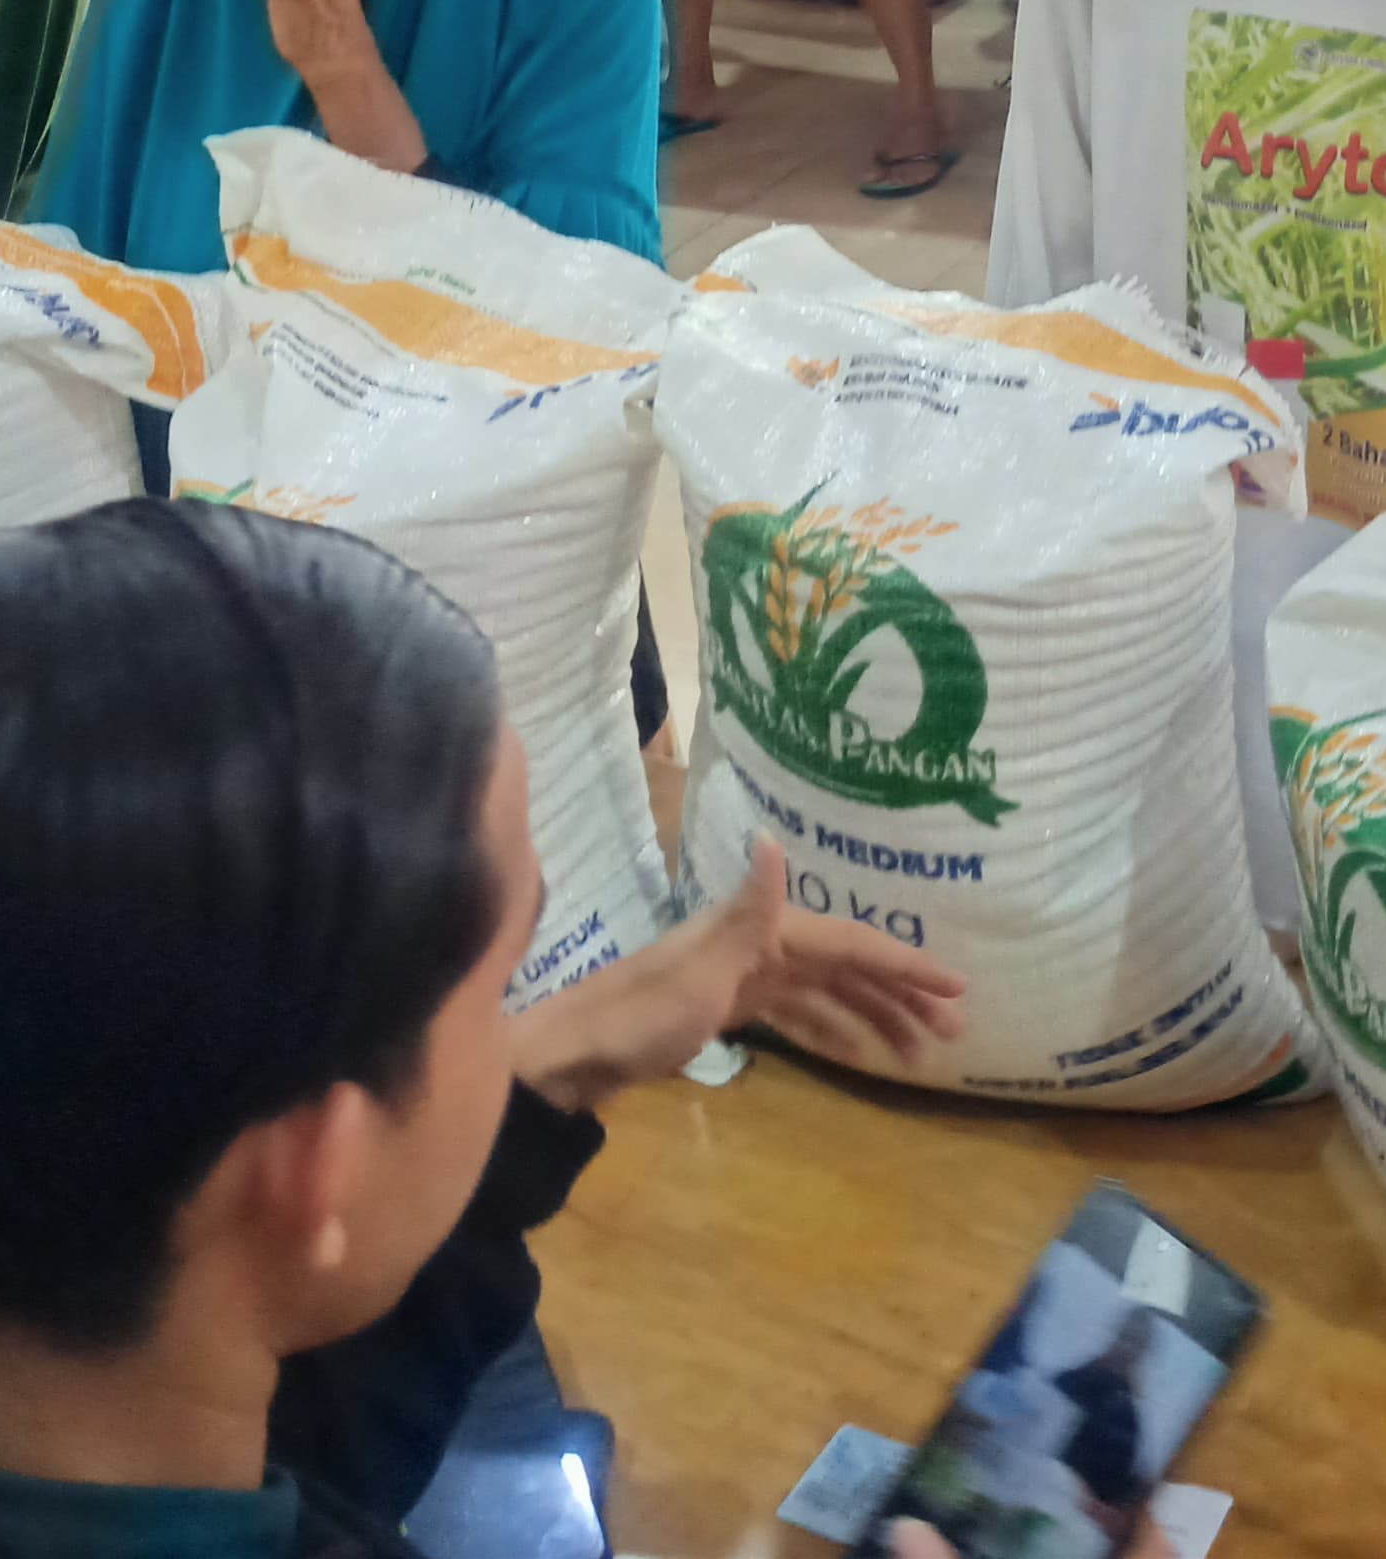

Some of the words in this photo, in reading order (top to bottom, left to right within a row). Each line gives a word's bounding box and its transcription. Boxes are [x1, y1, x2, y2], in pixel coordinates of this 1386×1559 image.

[1322, 423, 1334, 446] 2
[827, 708, 998, 786] PANGAN
[814, 823, 986, 883] MEDIUM
[521, 908, 605, 984] UNTUK
[849, 890, 926, 949] kg
